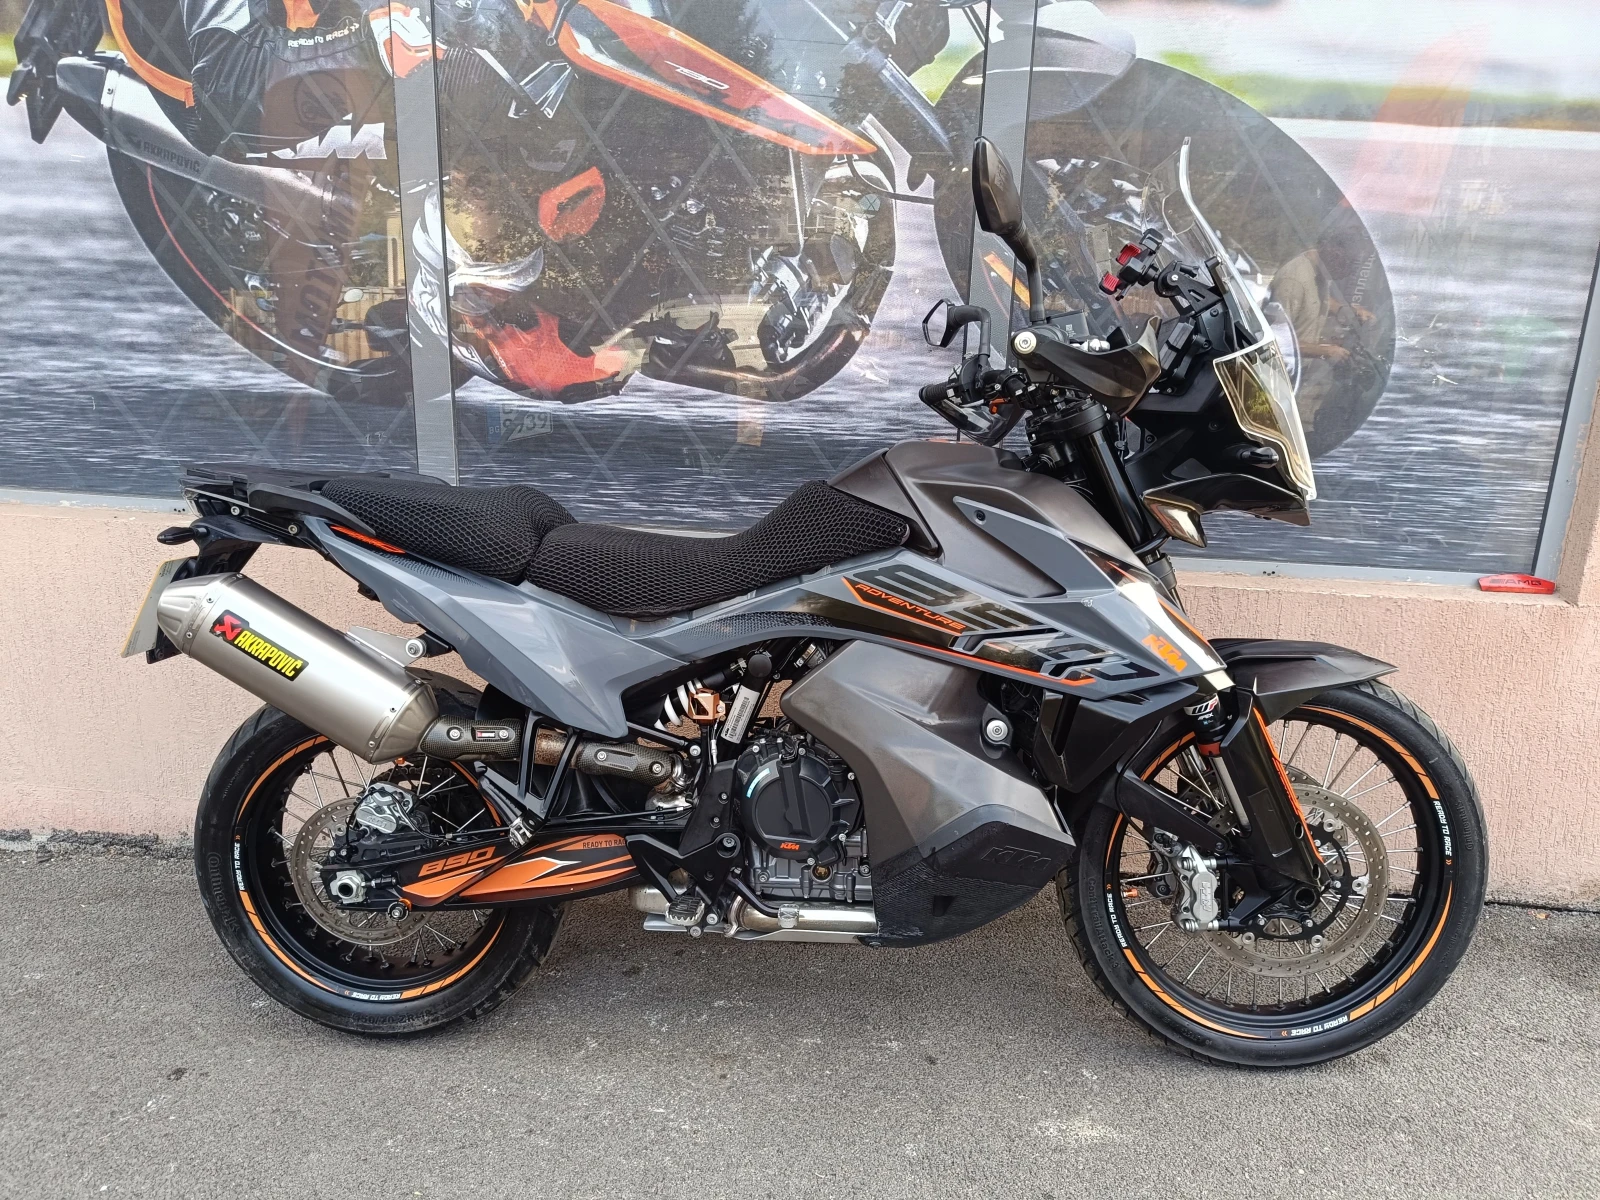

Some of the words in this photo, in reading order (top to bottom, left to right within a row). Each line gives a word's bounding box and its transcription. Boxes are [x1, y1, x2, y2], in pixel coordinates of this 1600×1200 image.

[287, 37, 314, 48] READY
[314, 35, 324, 44] TO
[325, 26, 350, 42] RACE
[855, 583, 967, 631] ADVENTURE
[1141, 633, 1188, 673] KTM
[1433, 800, 1447, 824] READY
[1442, 824, 1450, 835] TO
[233, 842, 241, 860] RACE
[582, 840, 604, 849] READY
[604, 839, 613, 847] TO
[780, 841, 800, 851] KTM
[1443, 836, 1453, 857] RACE
[234, 860, 241, 869] TO
[418, 846, 496, 877] 890
[980, 845, 1052, 872] KTM
[235, 869, 246, 891] READY
[1106, 892, 1115, 913] RACE
[1110, 914, 1118, 924] TO
[1113, 924, 1128, 948] READY
[351, 991, 370, 1000] RACE
[379, 993, 401, 1001] READY
[1312, 1025, 1324, 1033] TO
[1323, 1014, 1349, 1030] READY
[1290, 1027, 1312, 1037] RACE
